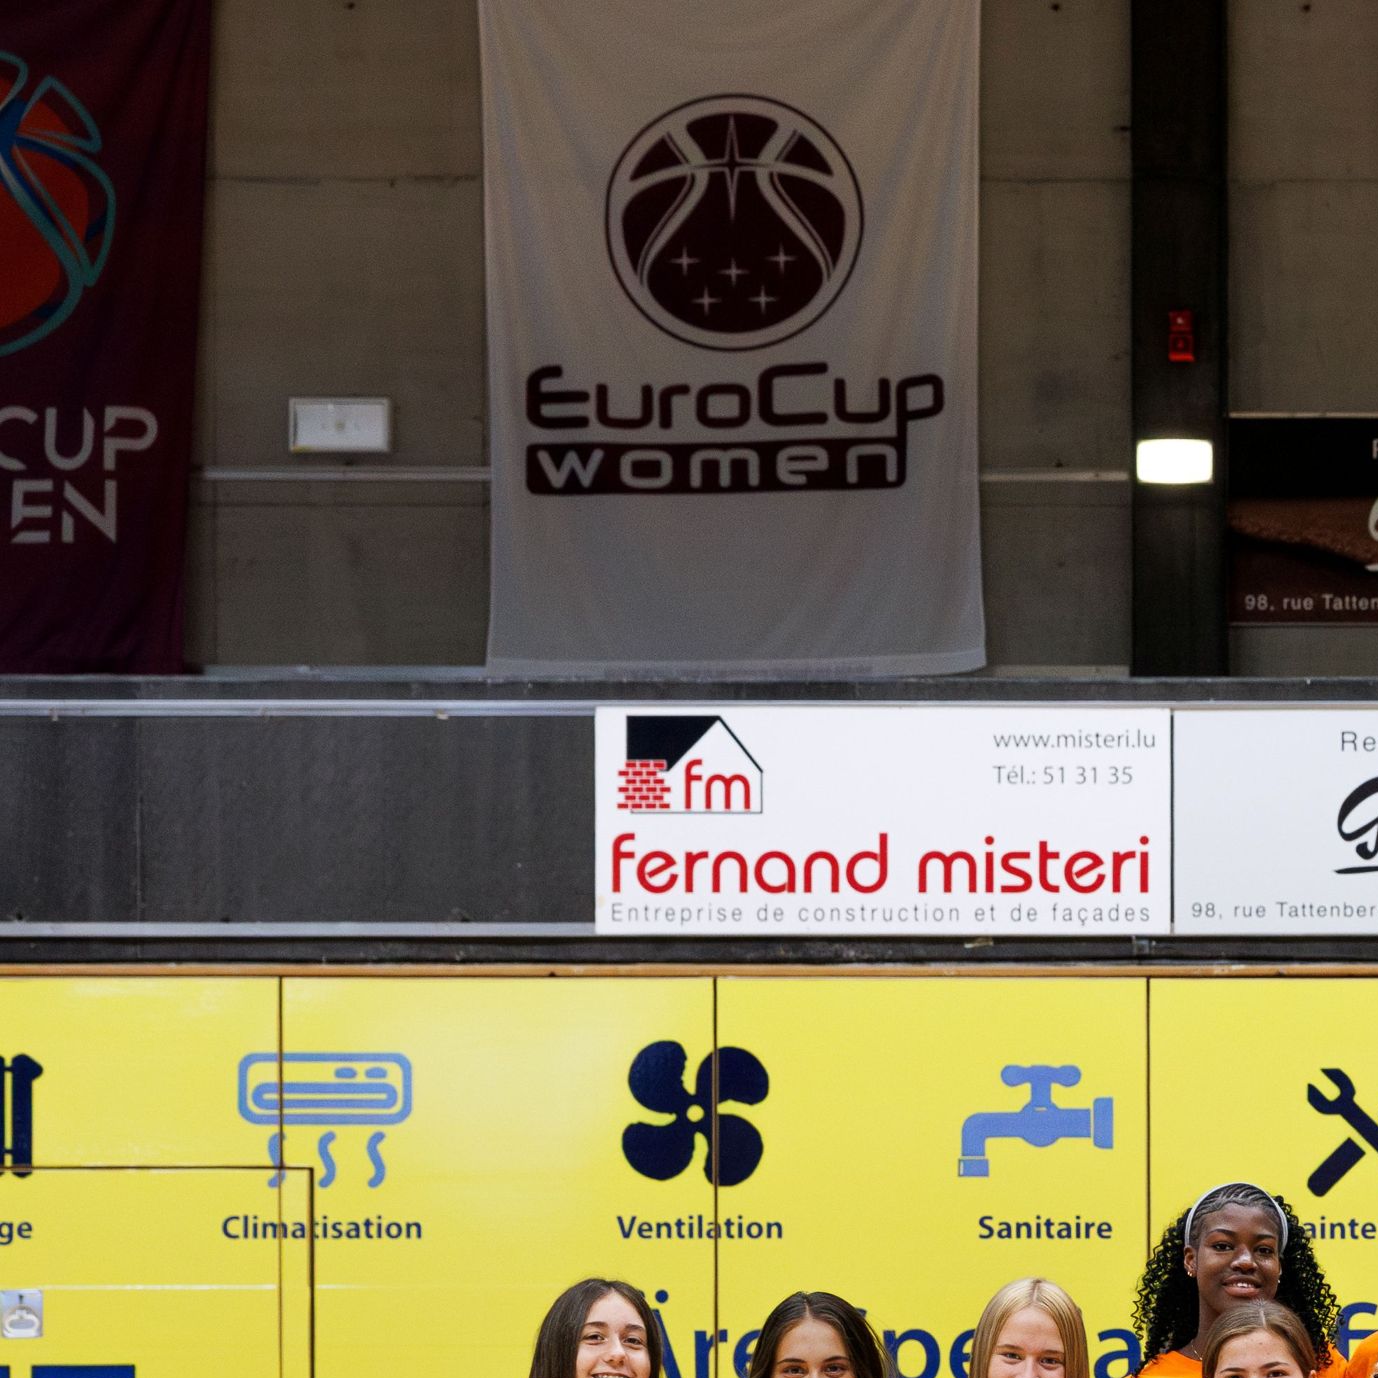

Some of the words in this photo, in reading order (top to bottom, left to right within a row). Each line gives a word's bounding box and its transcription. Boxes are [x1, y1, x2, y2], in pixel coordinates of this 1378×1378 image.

[526, 362, 944, 434] EuroCup
[537, 443, 898, 488] women
[1283, 598, 1316, 611] rue
[993, 730, 1156, 750] www.misteri.lu
[684, 759, 751, 811] fm
[993, 765, 1037, 785] Tél.:
[1043, 766, 1066, 785] 51
[1077, 766, 1100, 785] 31
[1108, 766, 1134, 785] 35
[611, 833, 888, 894] fernand
[918, 836, 1150, 894] misteri
[611, 903, 743, 926] Entreprise
[757, 903, 785, 923] de
[799, 903, 961, 923] construction
[974, 904, 997, 923] et
[1010, 903, 1038, 923] de
[1051, 903, 1150, 928] façades
[1190, 901, 1223, 921] 98,
[1232, 906, 1267, 919] rue
[222, 1214, 423, 1241] Climatisation
[616, 1214, 783, 1241] Ventilation
[977, 1214, 1112, 1241] Sanitaire
